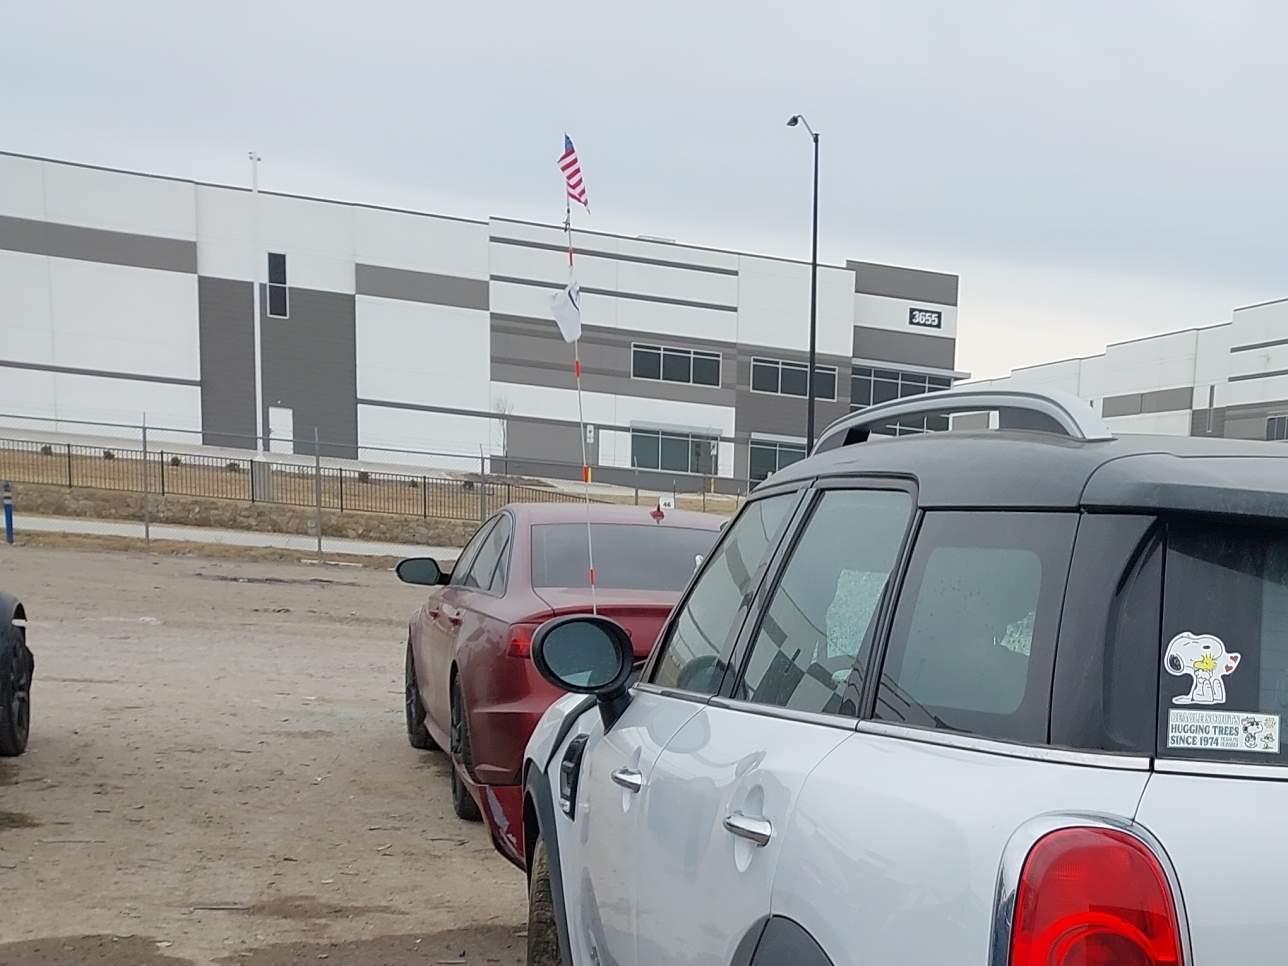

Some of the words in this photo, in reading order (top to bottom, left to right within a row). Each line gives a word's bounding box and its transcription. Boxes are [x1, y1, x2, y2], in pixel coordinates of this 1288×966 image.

[911, 310, 939, 326] 3655
[1170, 724, 1210, 735] HUGGING
[1211, 725, 1240, 736] TREES
[1170, 735, 1198, 746] SINCE
[1199, 736, 1219, 747] 1974
